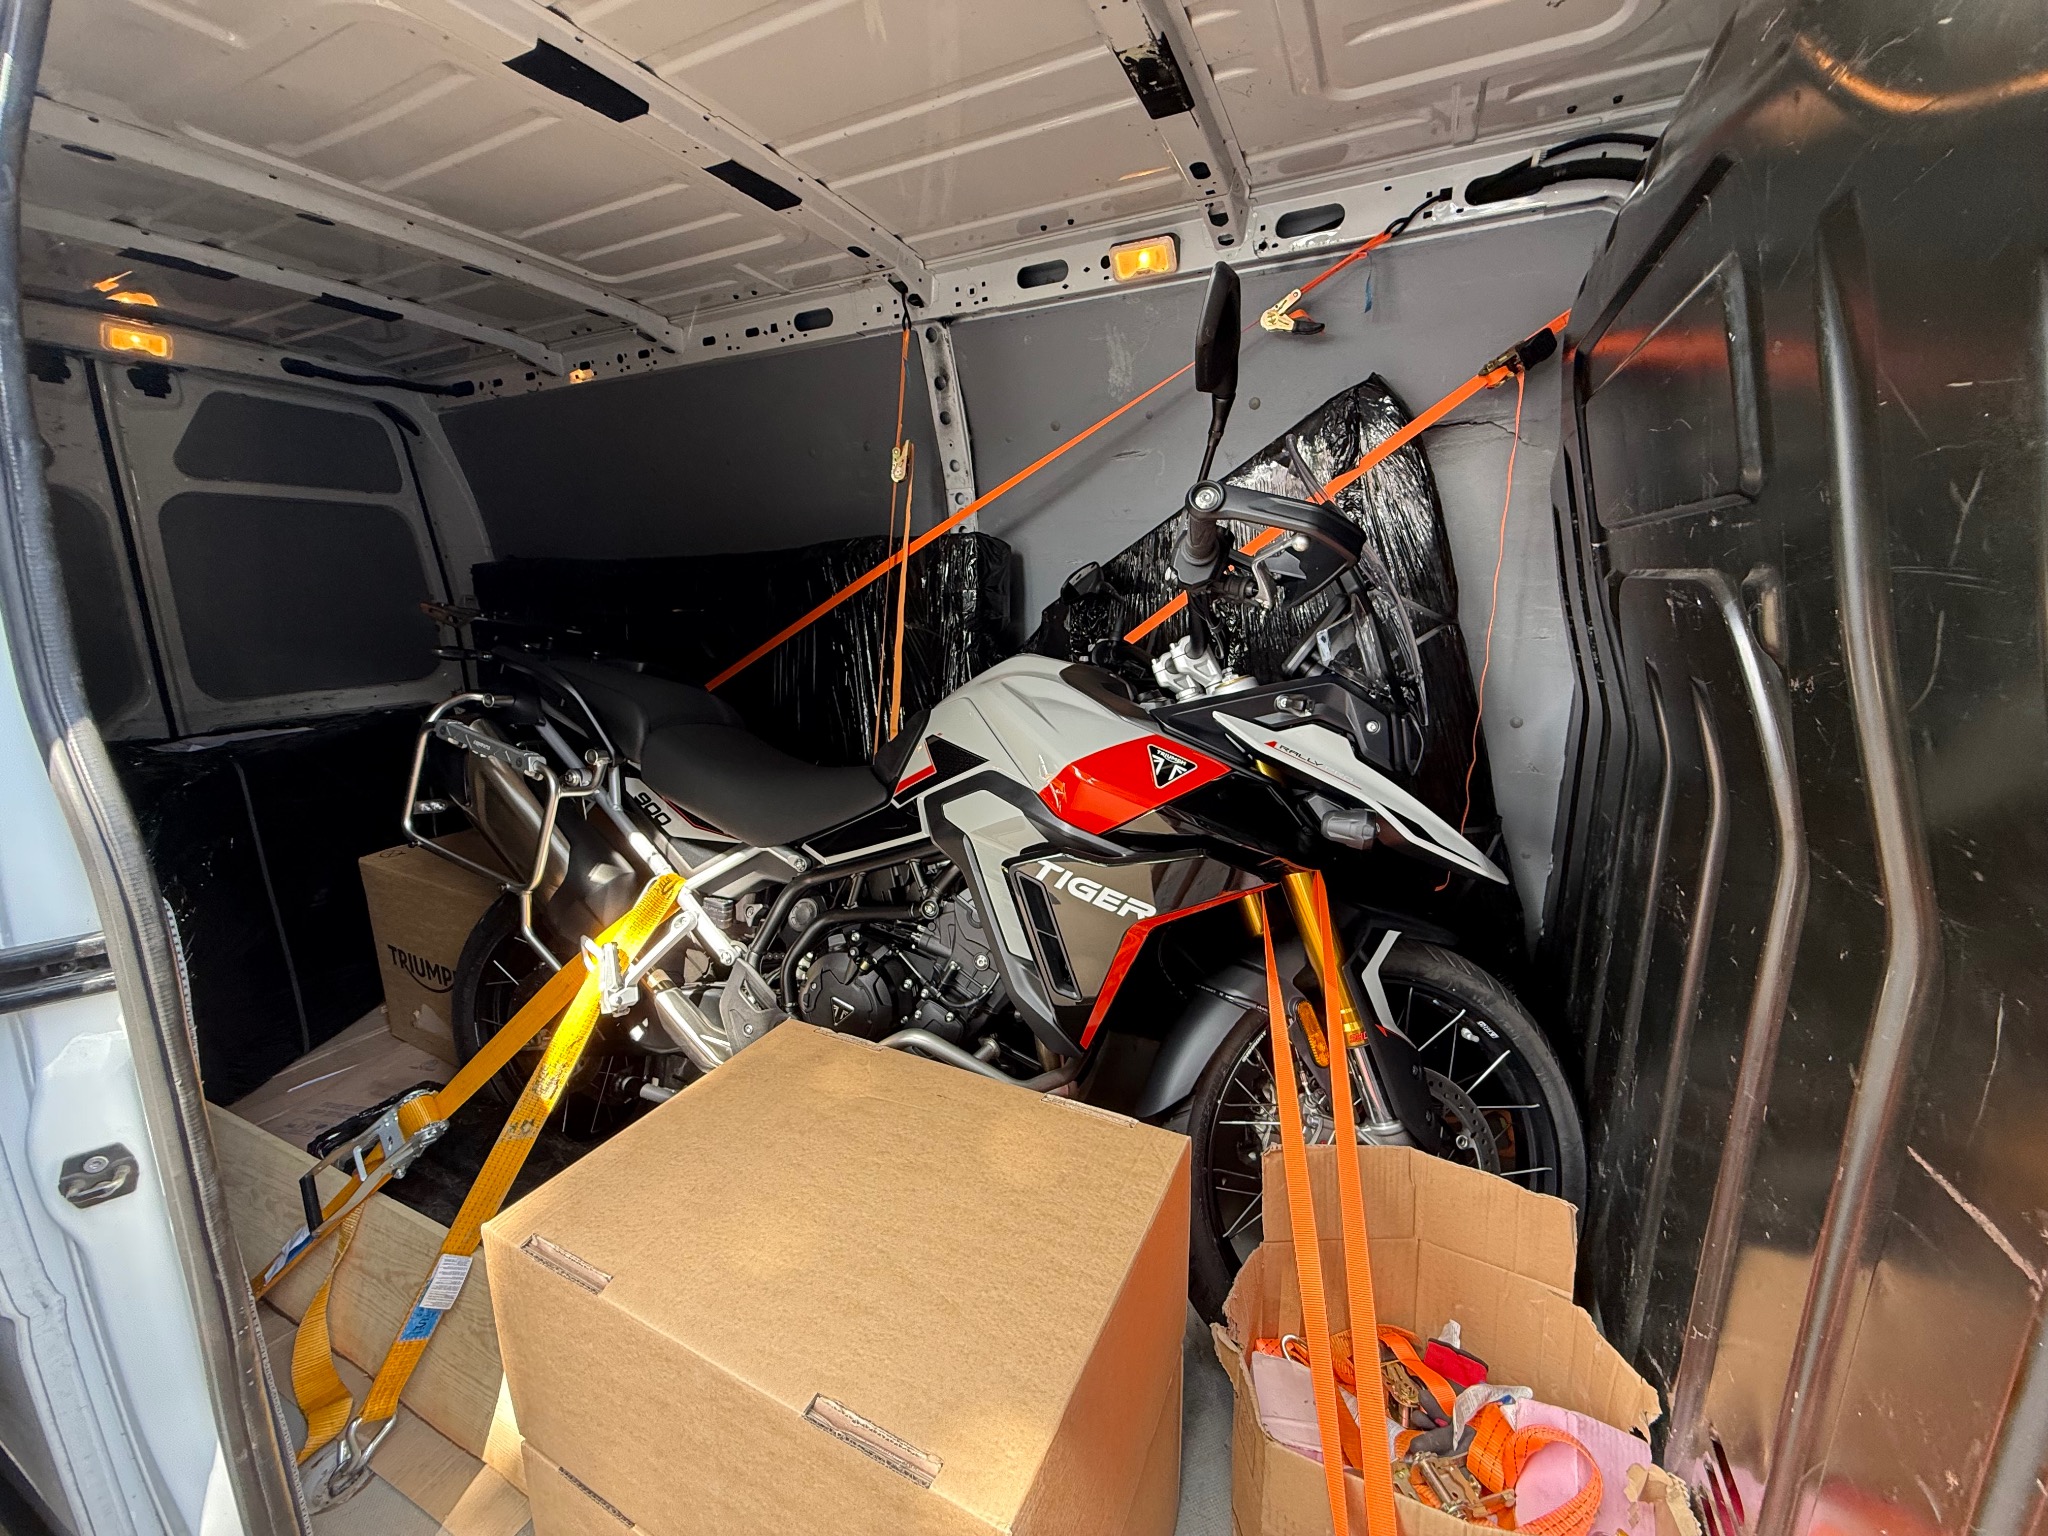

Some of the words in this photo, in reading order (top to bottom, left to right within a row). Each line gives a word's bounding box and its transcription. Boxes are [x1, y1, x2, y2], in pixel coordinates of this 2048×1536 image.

[1156, 749, 1187, 767] TRIUMPH
[1279, 745, 1323, 766] RALLY
[637, 791, 672, 826] 900
[1035, 859, 1157, 920] TIGER
[387, 944, 457, 992] TRIUMP
